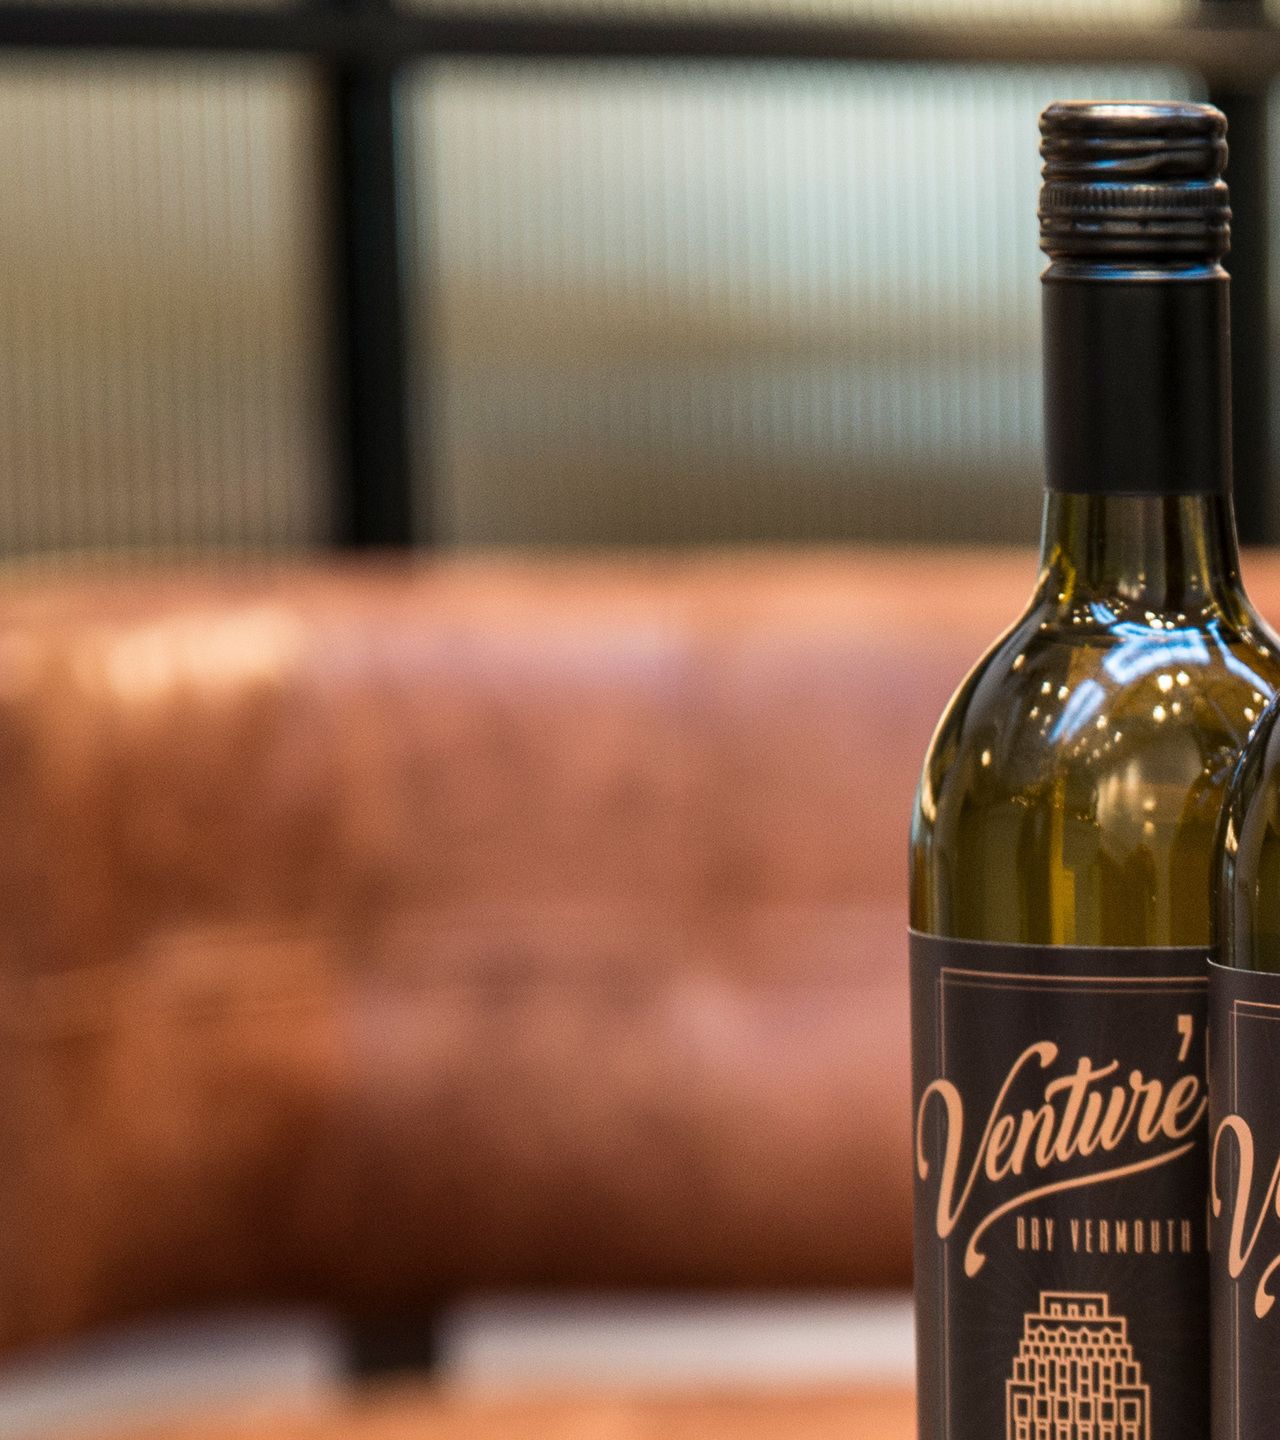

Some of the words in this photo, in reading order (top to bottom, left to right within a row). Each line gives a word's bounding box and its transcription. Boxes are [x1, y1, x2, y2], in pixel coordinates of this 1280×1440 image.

[917, 1040, 1207, 1252] Venture
[1016, 1216, 1053, 1251] DRY
[1070, 1217, 1192, 1254] VERMOUTH
